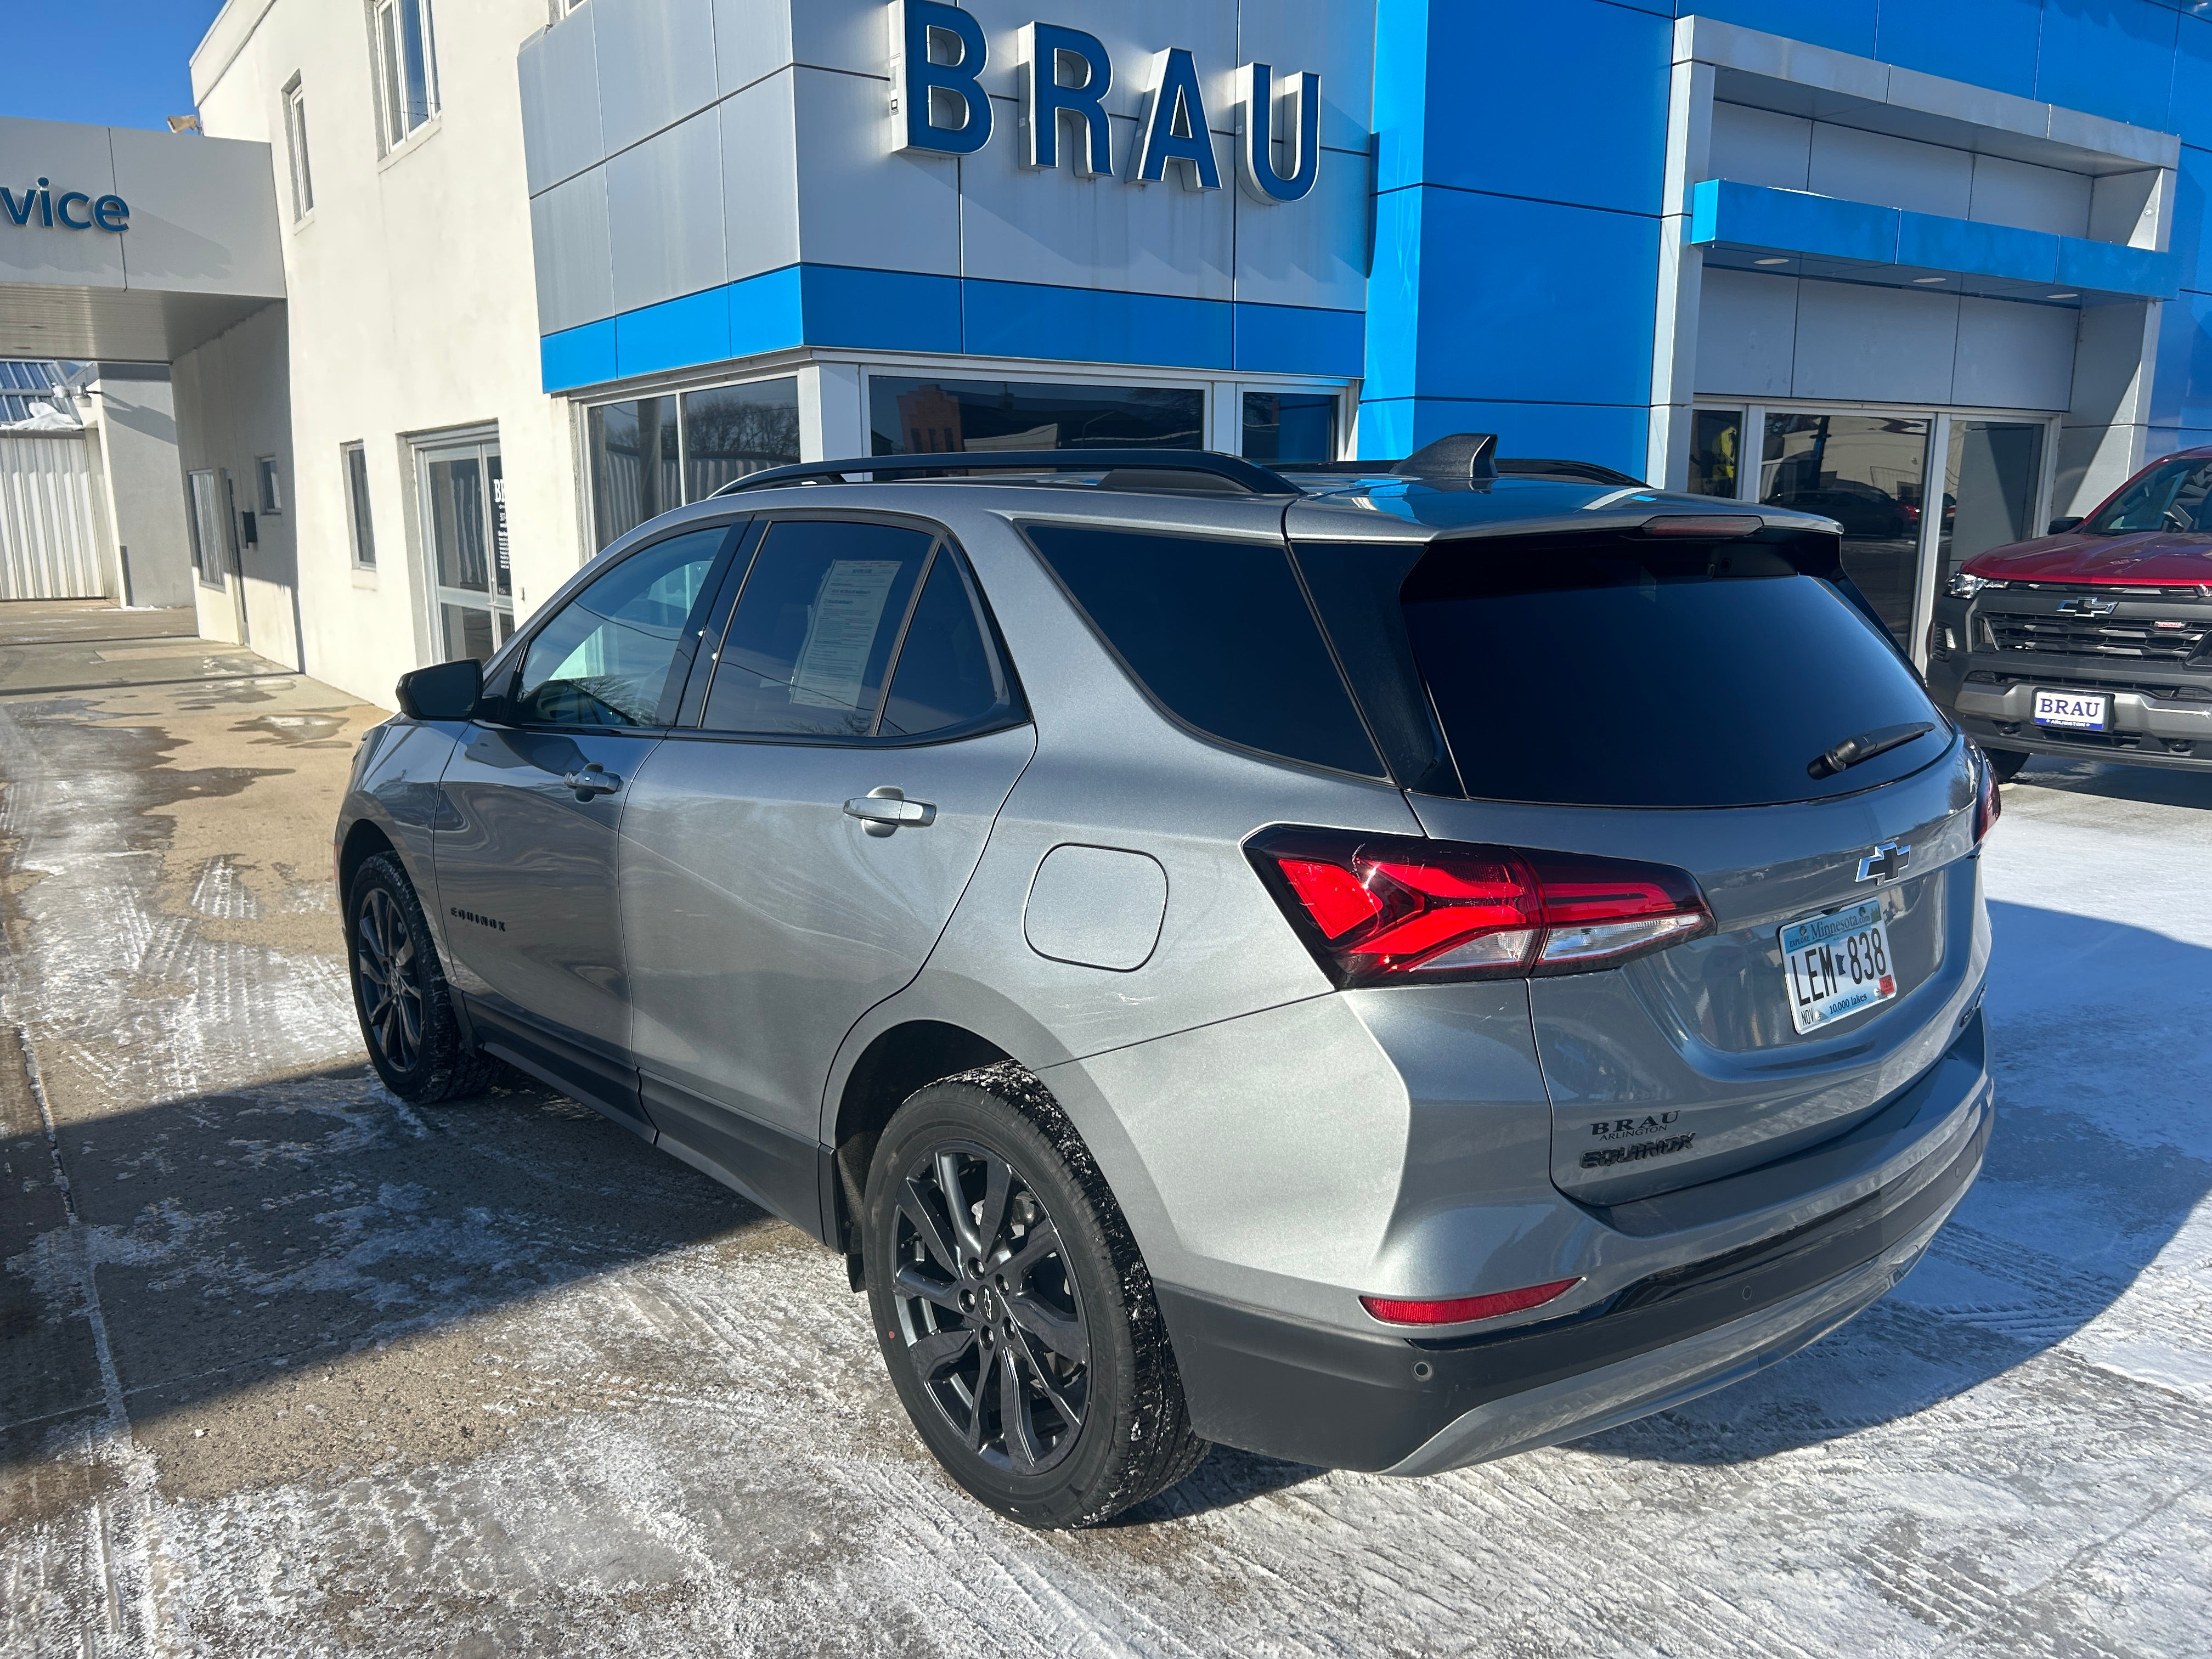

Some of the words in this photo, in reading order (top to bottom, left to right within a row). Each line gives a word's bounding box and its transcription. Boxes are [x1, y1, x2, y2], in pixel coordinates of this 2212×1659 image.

[889, 0, 1322, 205] BRAU
[2039, 698, 2101, 717] BRAU
[2050, 719, 2085, 727] ARLINGTON
[450, 906, 506, 932] EQUINOX
[1789, 935, 1810, 947] EXPLORE
[1791, 944, 1837, 1007] LEM
[1847, 928, 1886, 985] 838
[1829, 998, 1850, 1014] 10,000
[1851, 993, 1867, 1005] lakes
[1801, 1008, 1815, 1026] NOV
[1590, 1109, 1681, 1136] BRAU
[1598, 1125, 1667, 1141] ARLINGTON
[1579, 1132, 1696, 1169] EQUINOX
